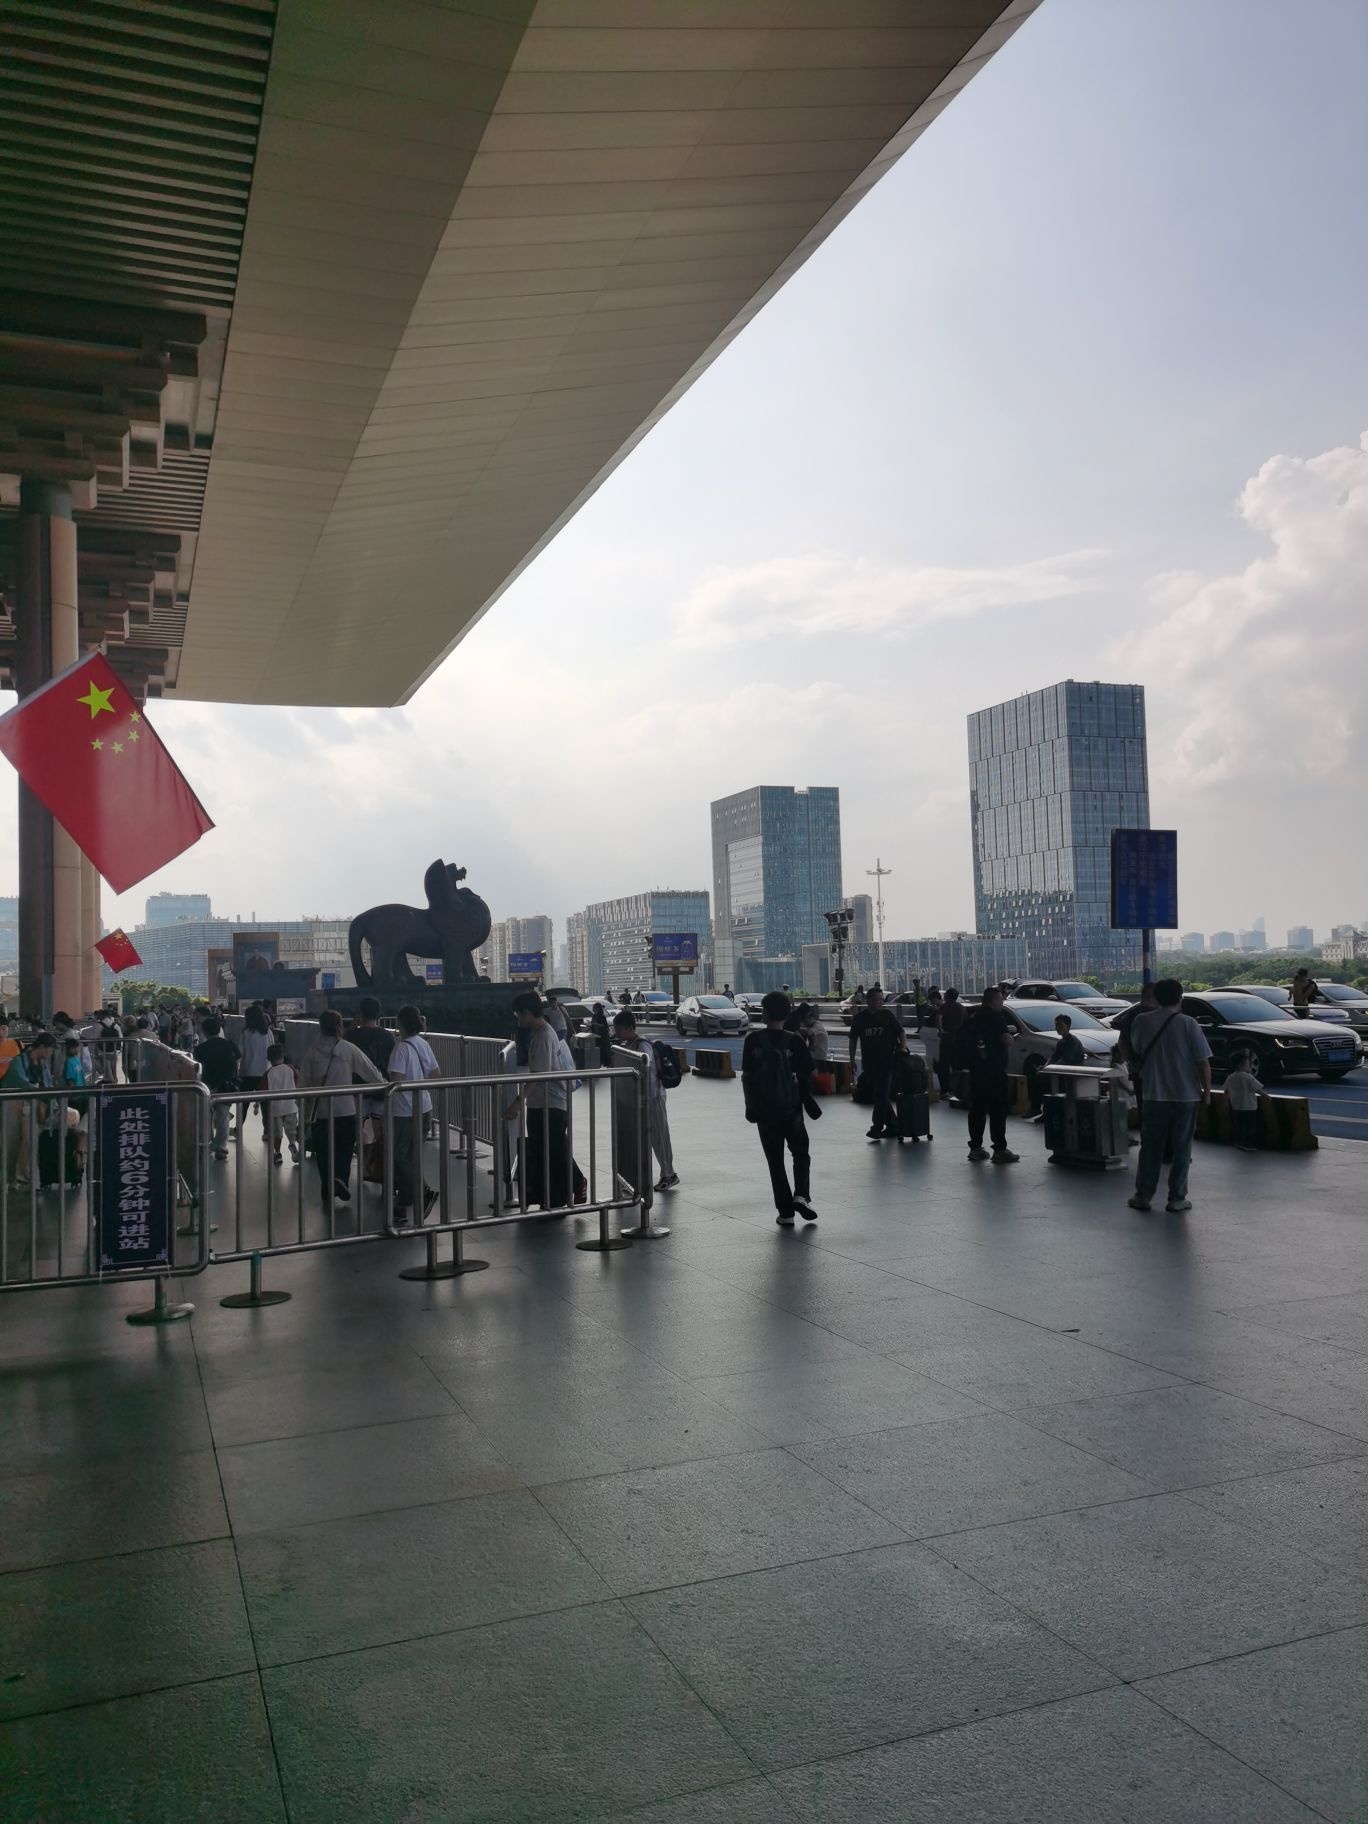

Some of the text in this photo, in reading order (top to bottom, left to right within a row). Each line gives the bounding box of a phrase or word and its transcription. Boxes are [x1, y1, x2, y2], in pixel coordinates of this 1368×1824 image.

[118, 1107, 151, 1250] 此处排队约6分钟可进站
